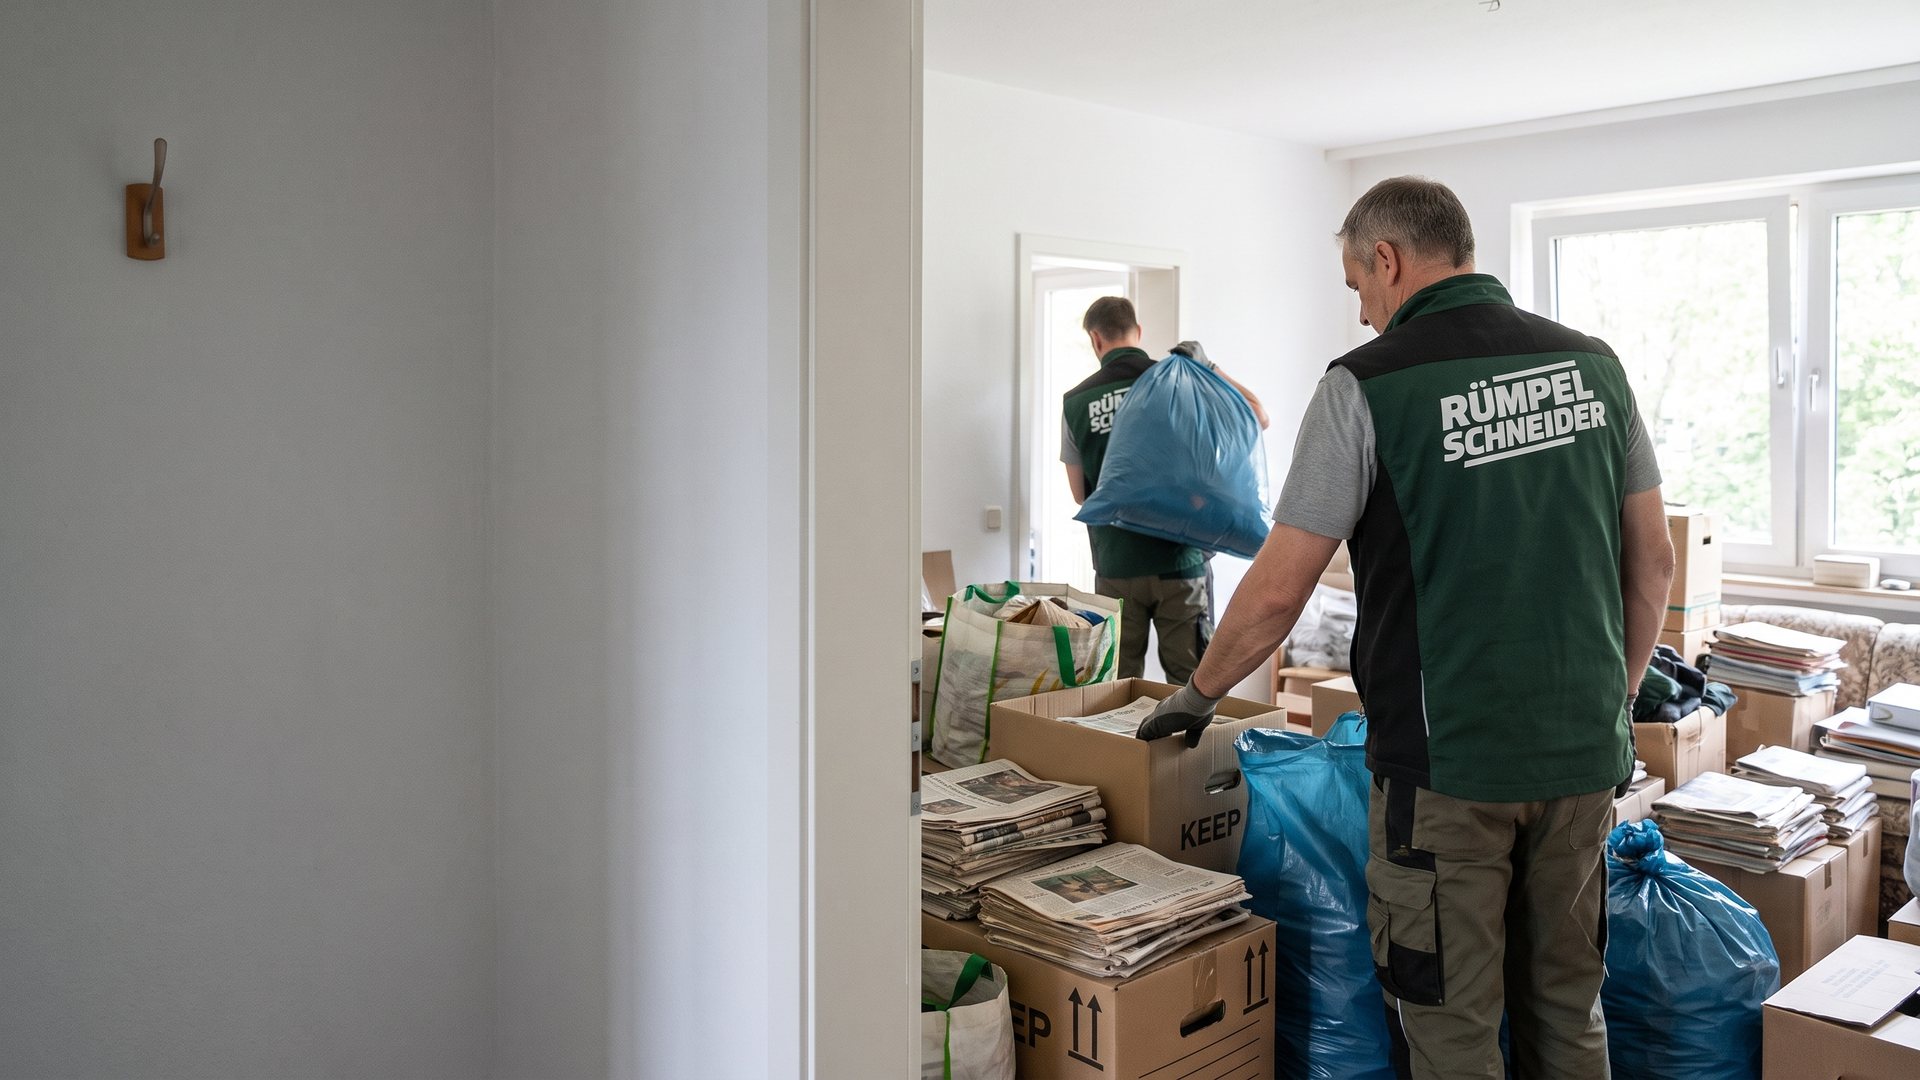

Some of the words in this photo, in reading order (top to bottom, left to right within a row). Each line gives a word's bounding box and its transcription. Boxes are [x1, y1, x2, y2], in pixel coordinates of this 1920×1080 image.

[1440, 369, 1594, 431] RÜMPEL
[1443, 401, 1607, 462] SCHNEIDER
[1181, 809, 1241, 851] KEEP
